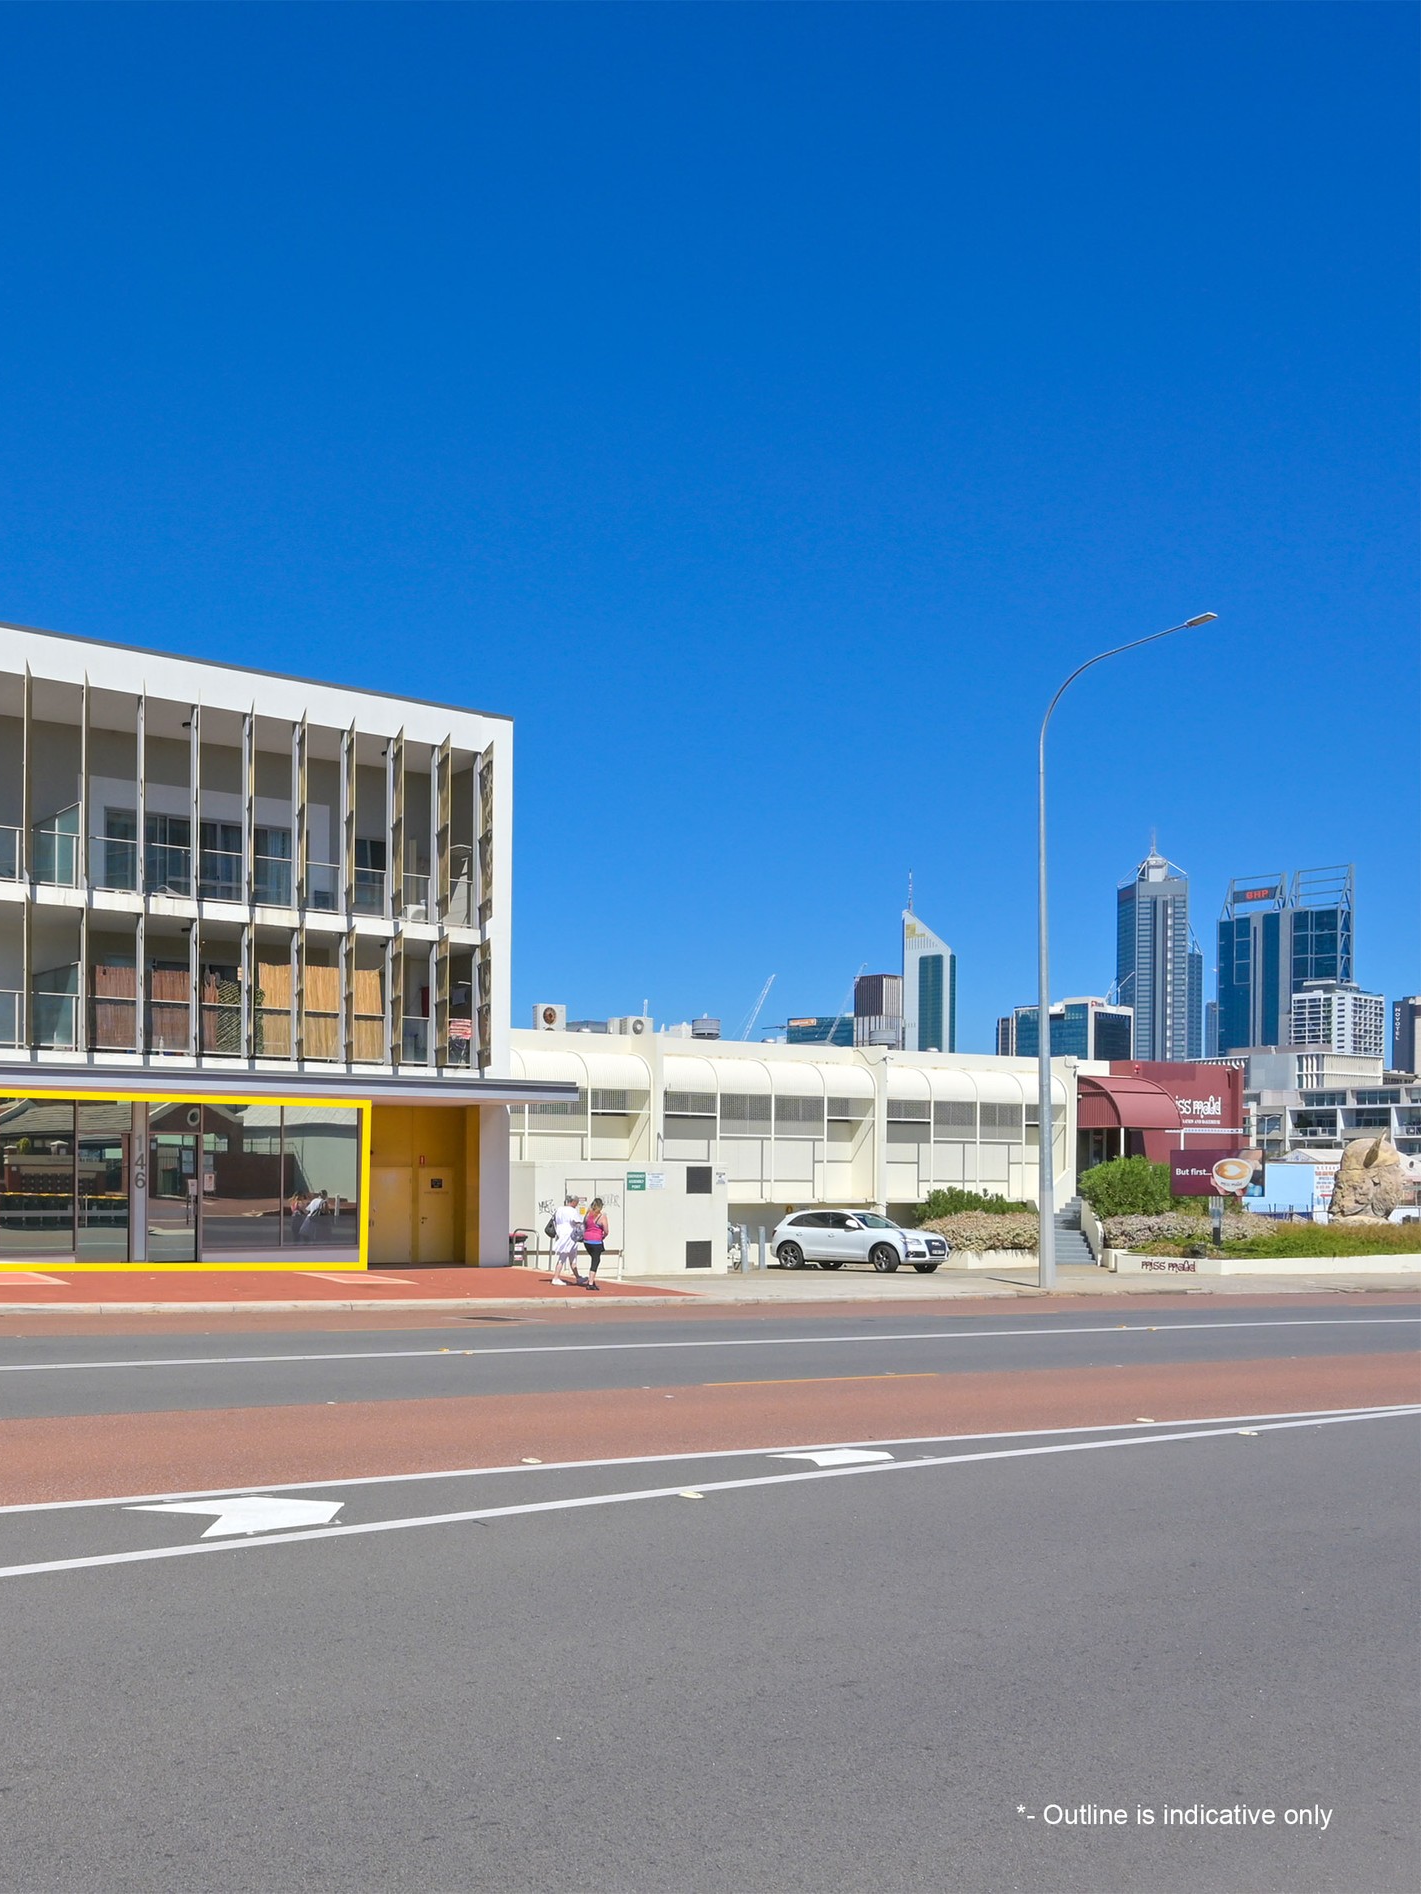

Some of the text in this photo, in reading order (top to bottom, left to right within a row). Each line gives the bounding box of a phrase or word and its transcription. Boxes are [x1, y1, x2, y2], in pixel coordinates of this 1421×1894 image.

[1245, 889, 1269, 900] BHP
[1175, 1095, 1222, 1119] iss maud
[134, 1134, 146, 1189] 146
[1175, 1167, 1212, 1176] But first...
[1141, 1259, 1196, 1273] miss maud
